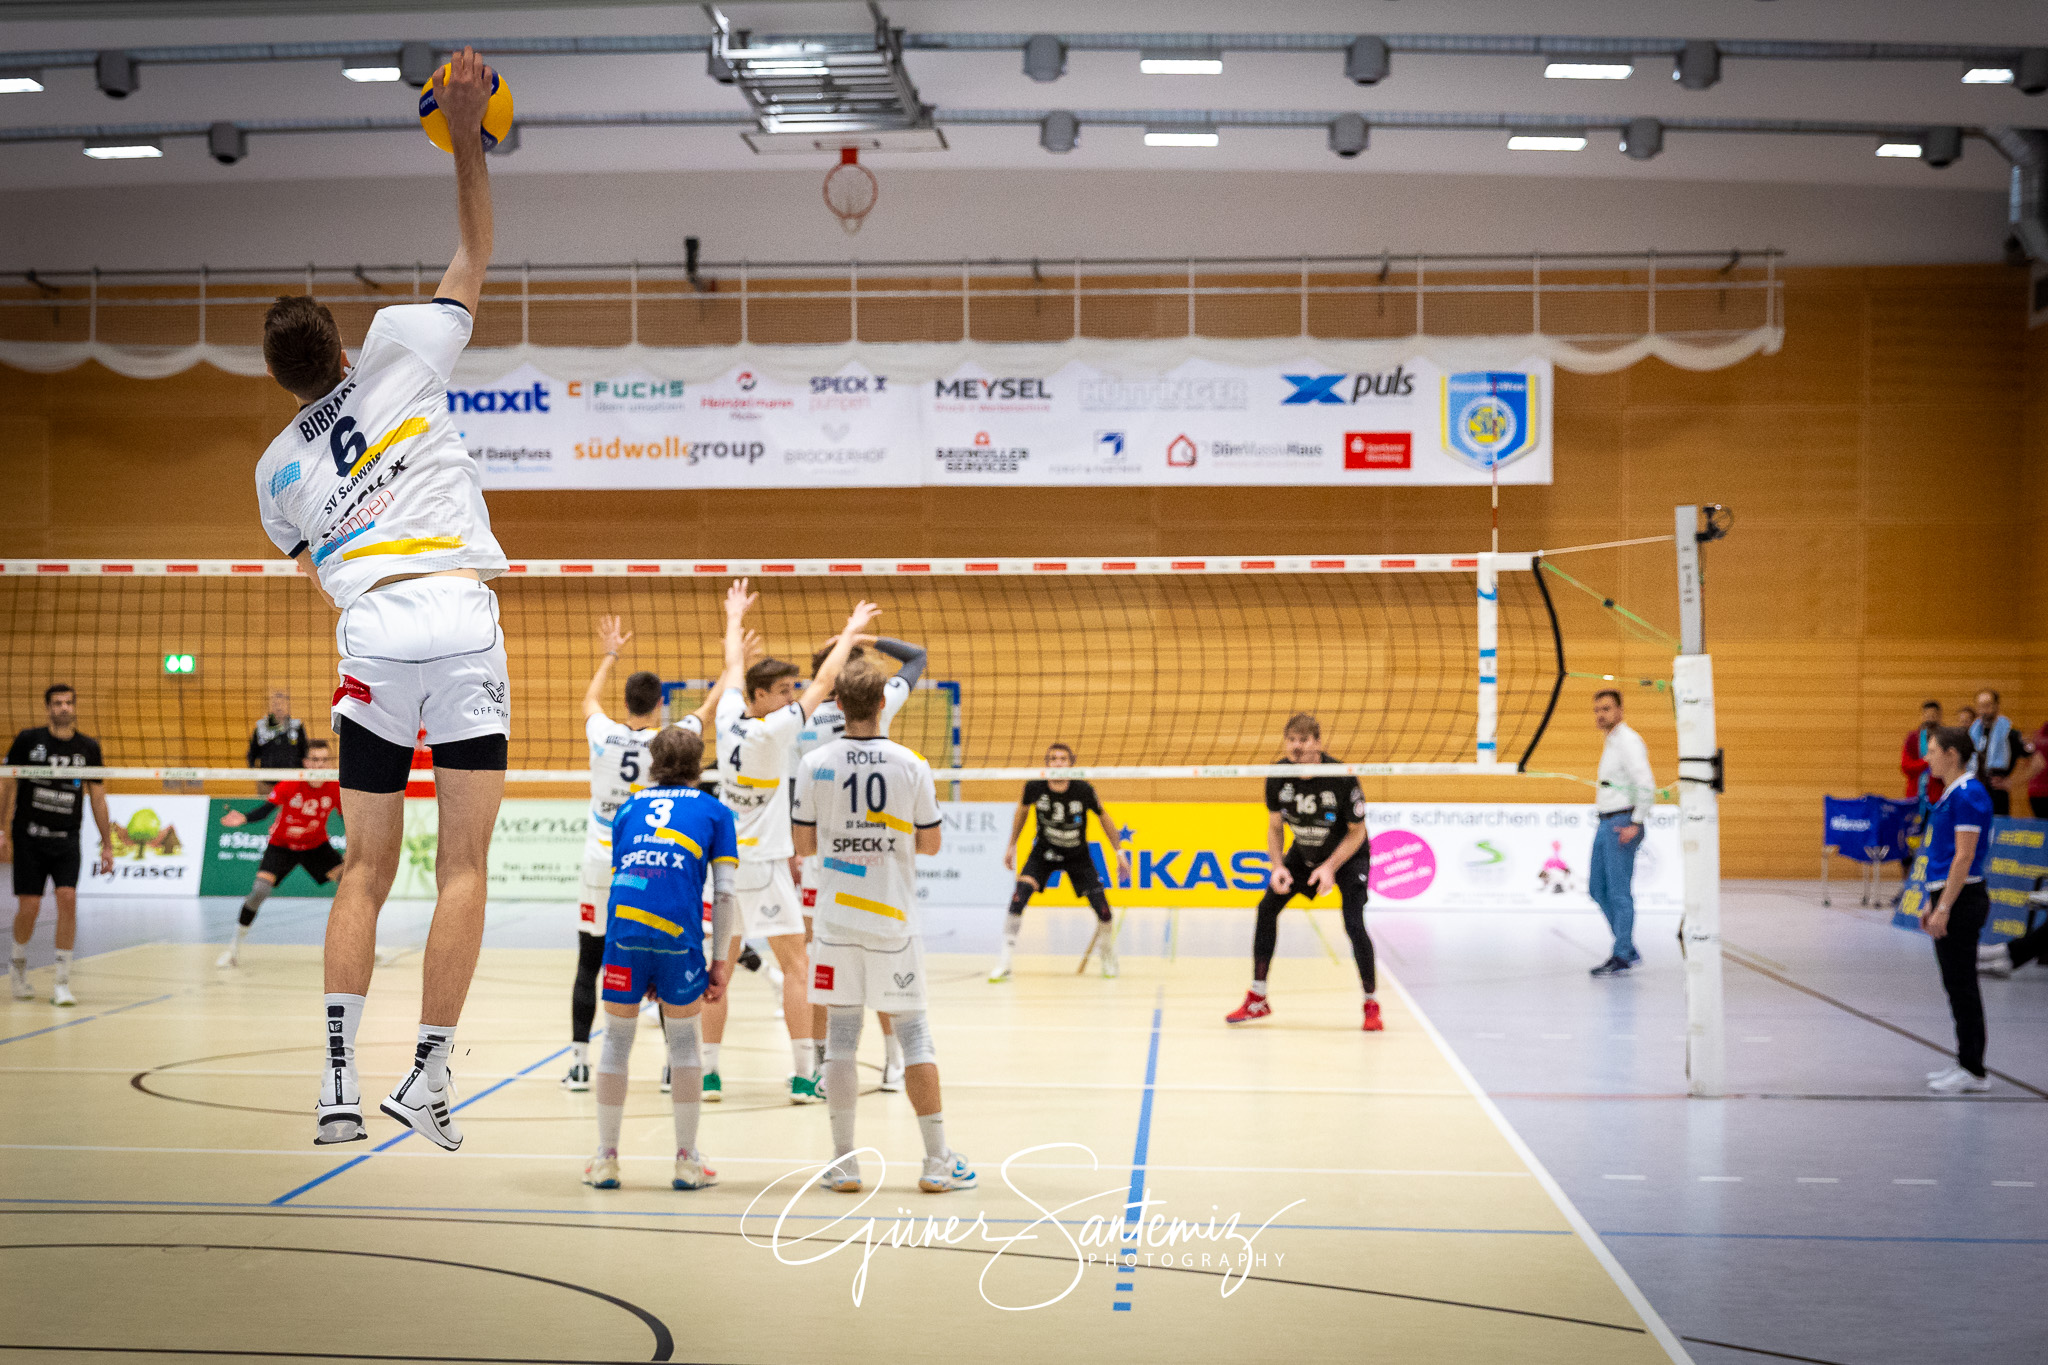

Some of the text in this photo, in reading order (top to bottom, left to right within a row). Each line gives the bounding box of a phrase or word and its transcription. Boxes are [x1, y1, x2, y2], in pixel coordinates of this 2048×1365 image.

[594, 380, 684, 398] FUCHS
[936, 379, 1051, 399] MEYSEL
[1351, 363, 1416, 404] puls
[330, 416, 367, 477] 6
[325, 495, 338, 515] SV
[324, 490, 395, 553] pumpen
[620, 750, 640, 782] 5
[729, 744, 742, 771] 4
[847, 751, 887, 764] ROLL
[843, 772, 887, 813] 10
[1294, 793, 1317, 815] 16
[645, 798, 674, 827] 3
[833, 838, 882, 853] SPECK
[621, 850, 668, 869] SPECK
